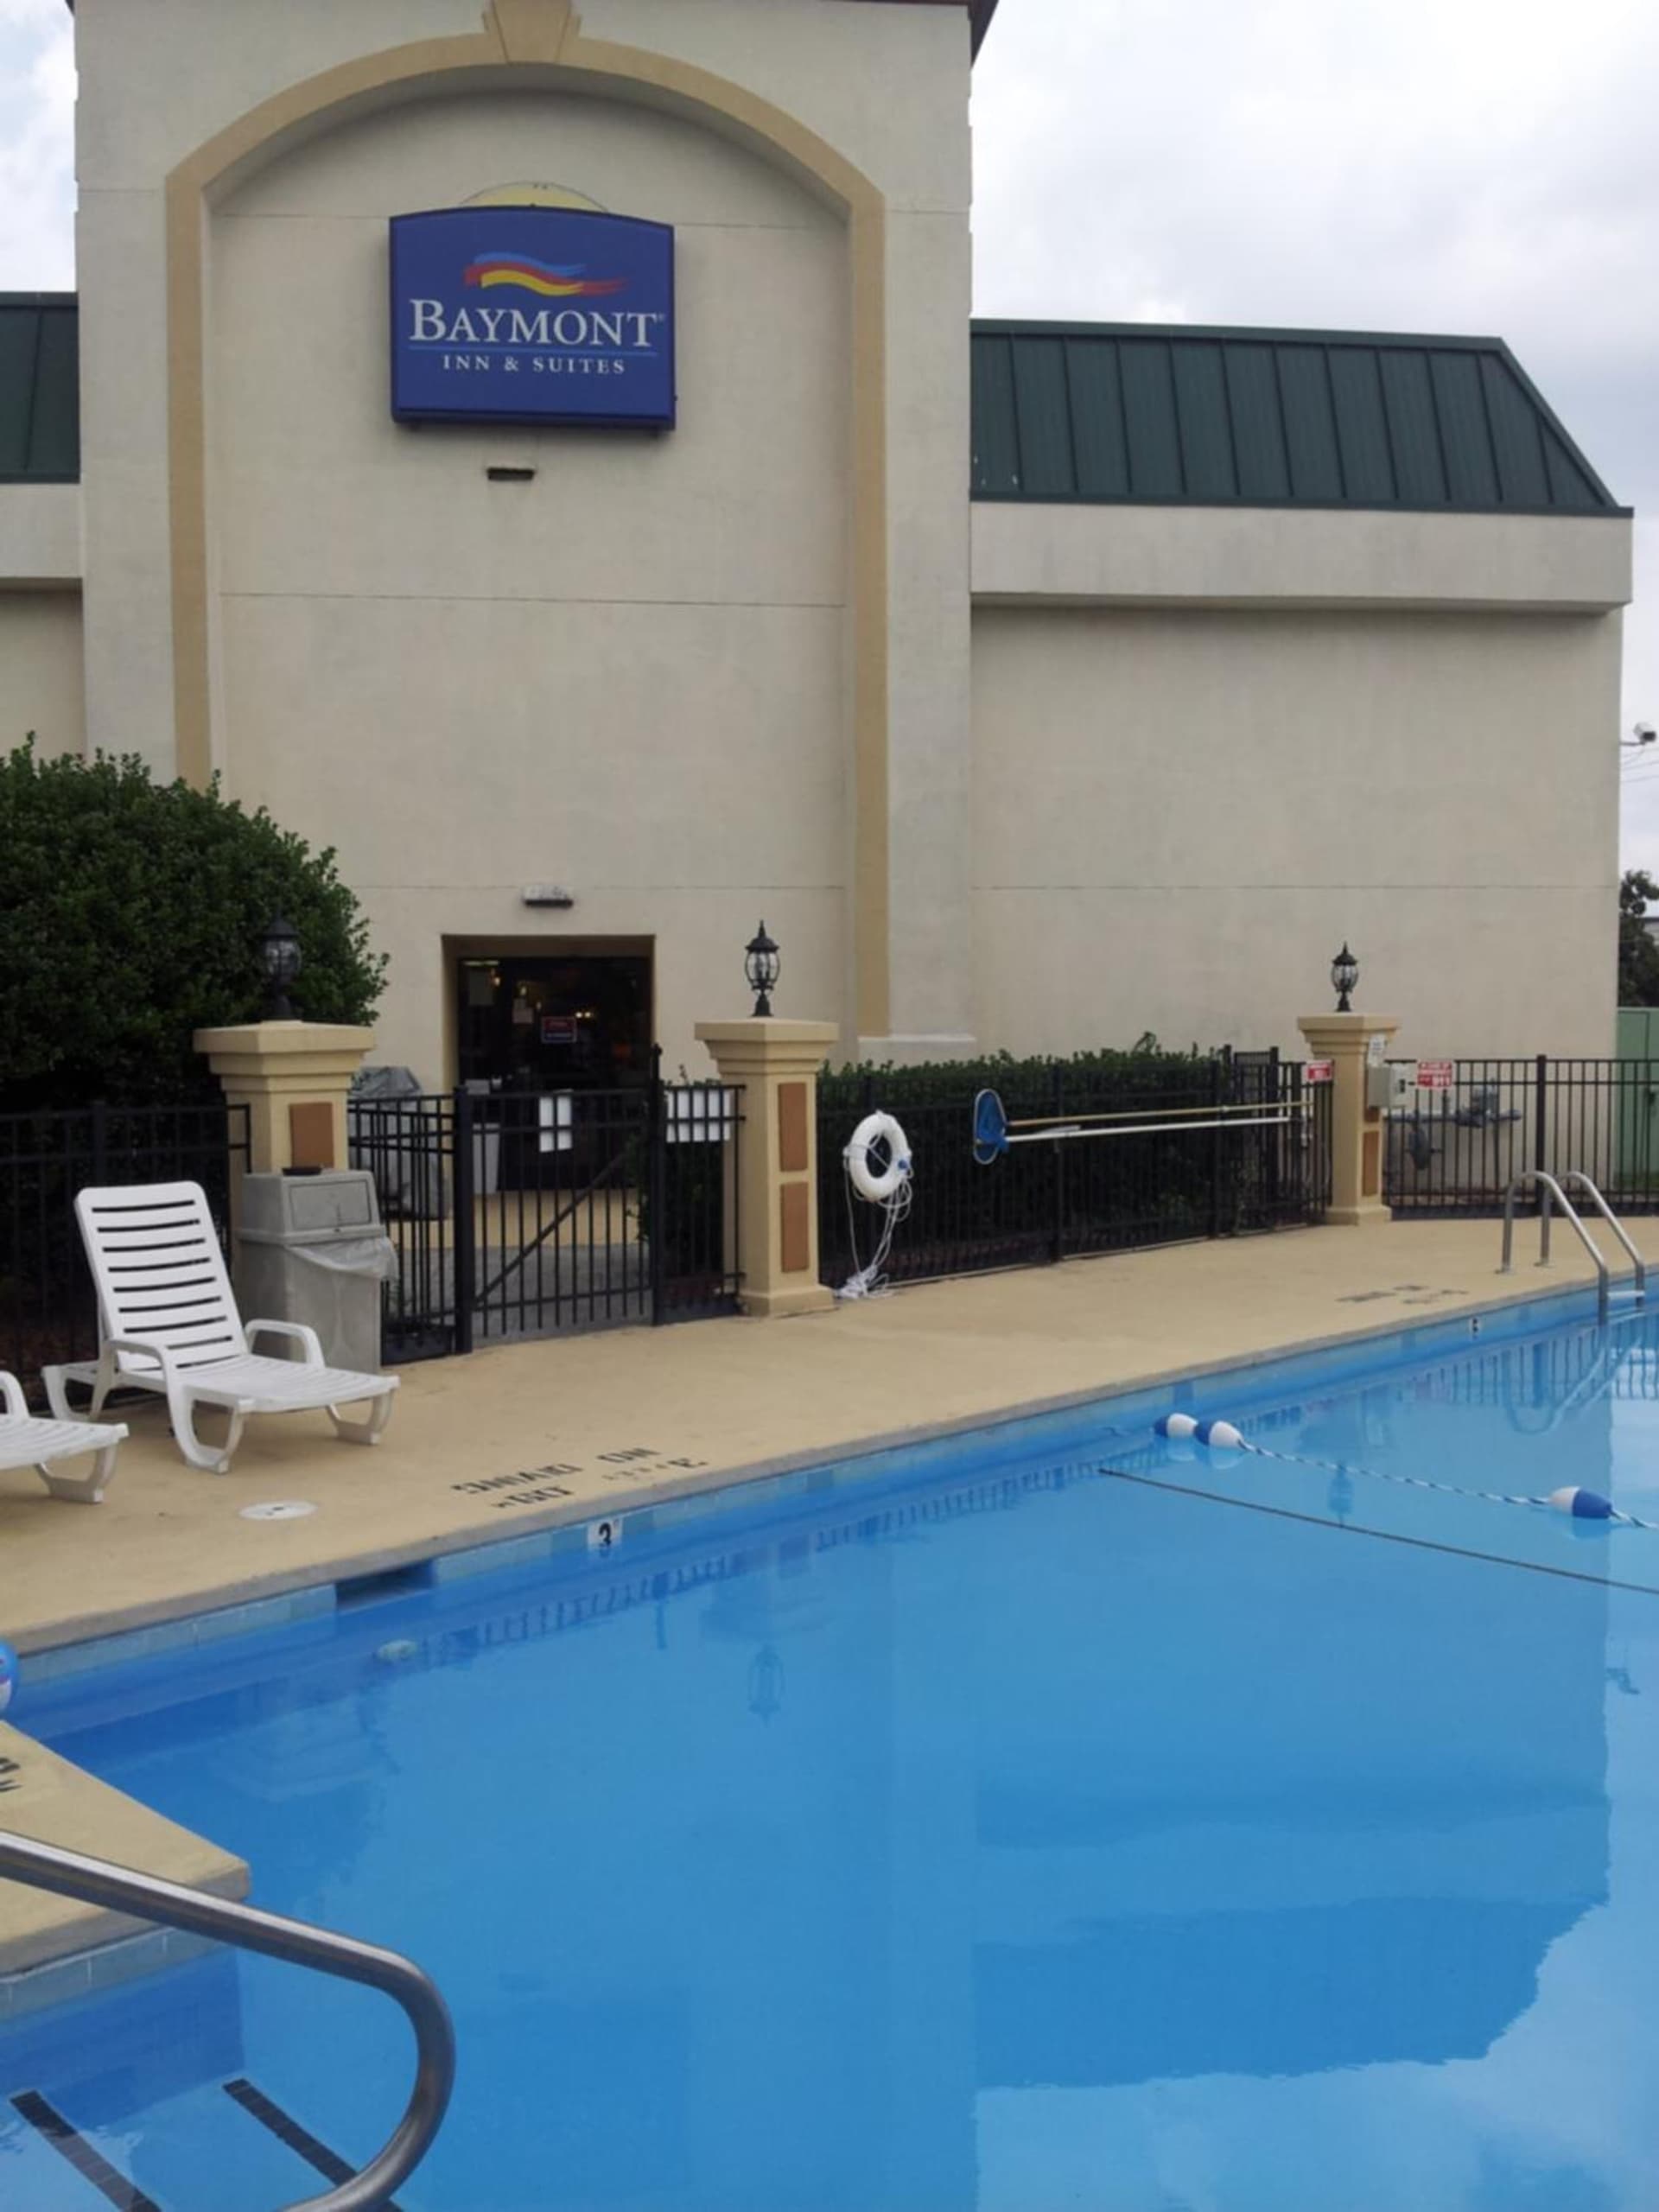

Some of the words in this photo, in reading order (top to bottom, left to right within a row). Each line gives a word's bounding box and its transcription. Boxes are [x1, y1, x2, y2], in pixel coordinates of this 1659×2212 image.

[409, 298, 659, 347] BAYMONT
[442, 354, 491, 371] INN
[504, 356, 519, 372] &
[532, 357, 626, 374] SUITES
